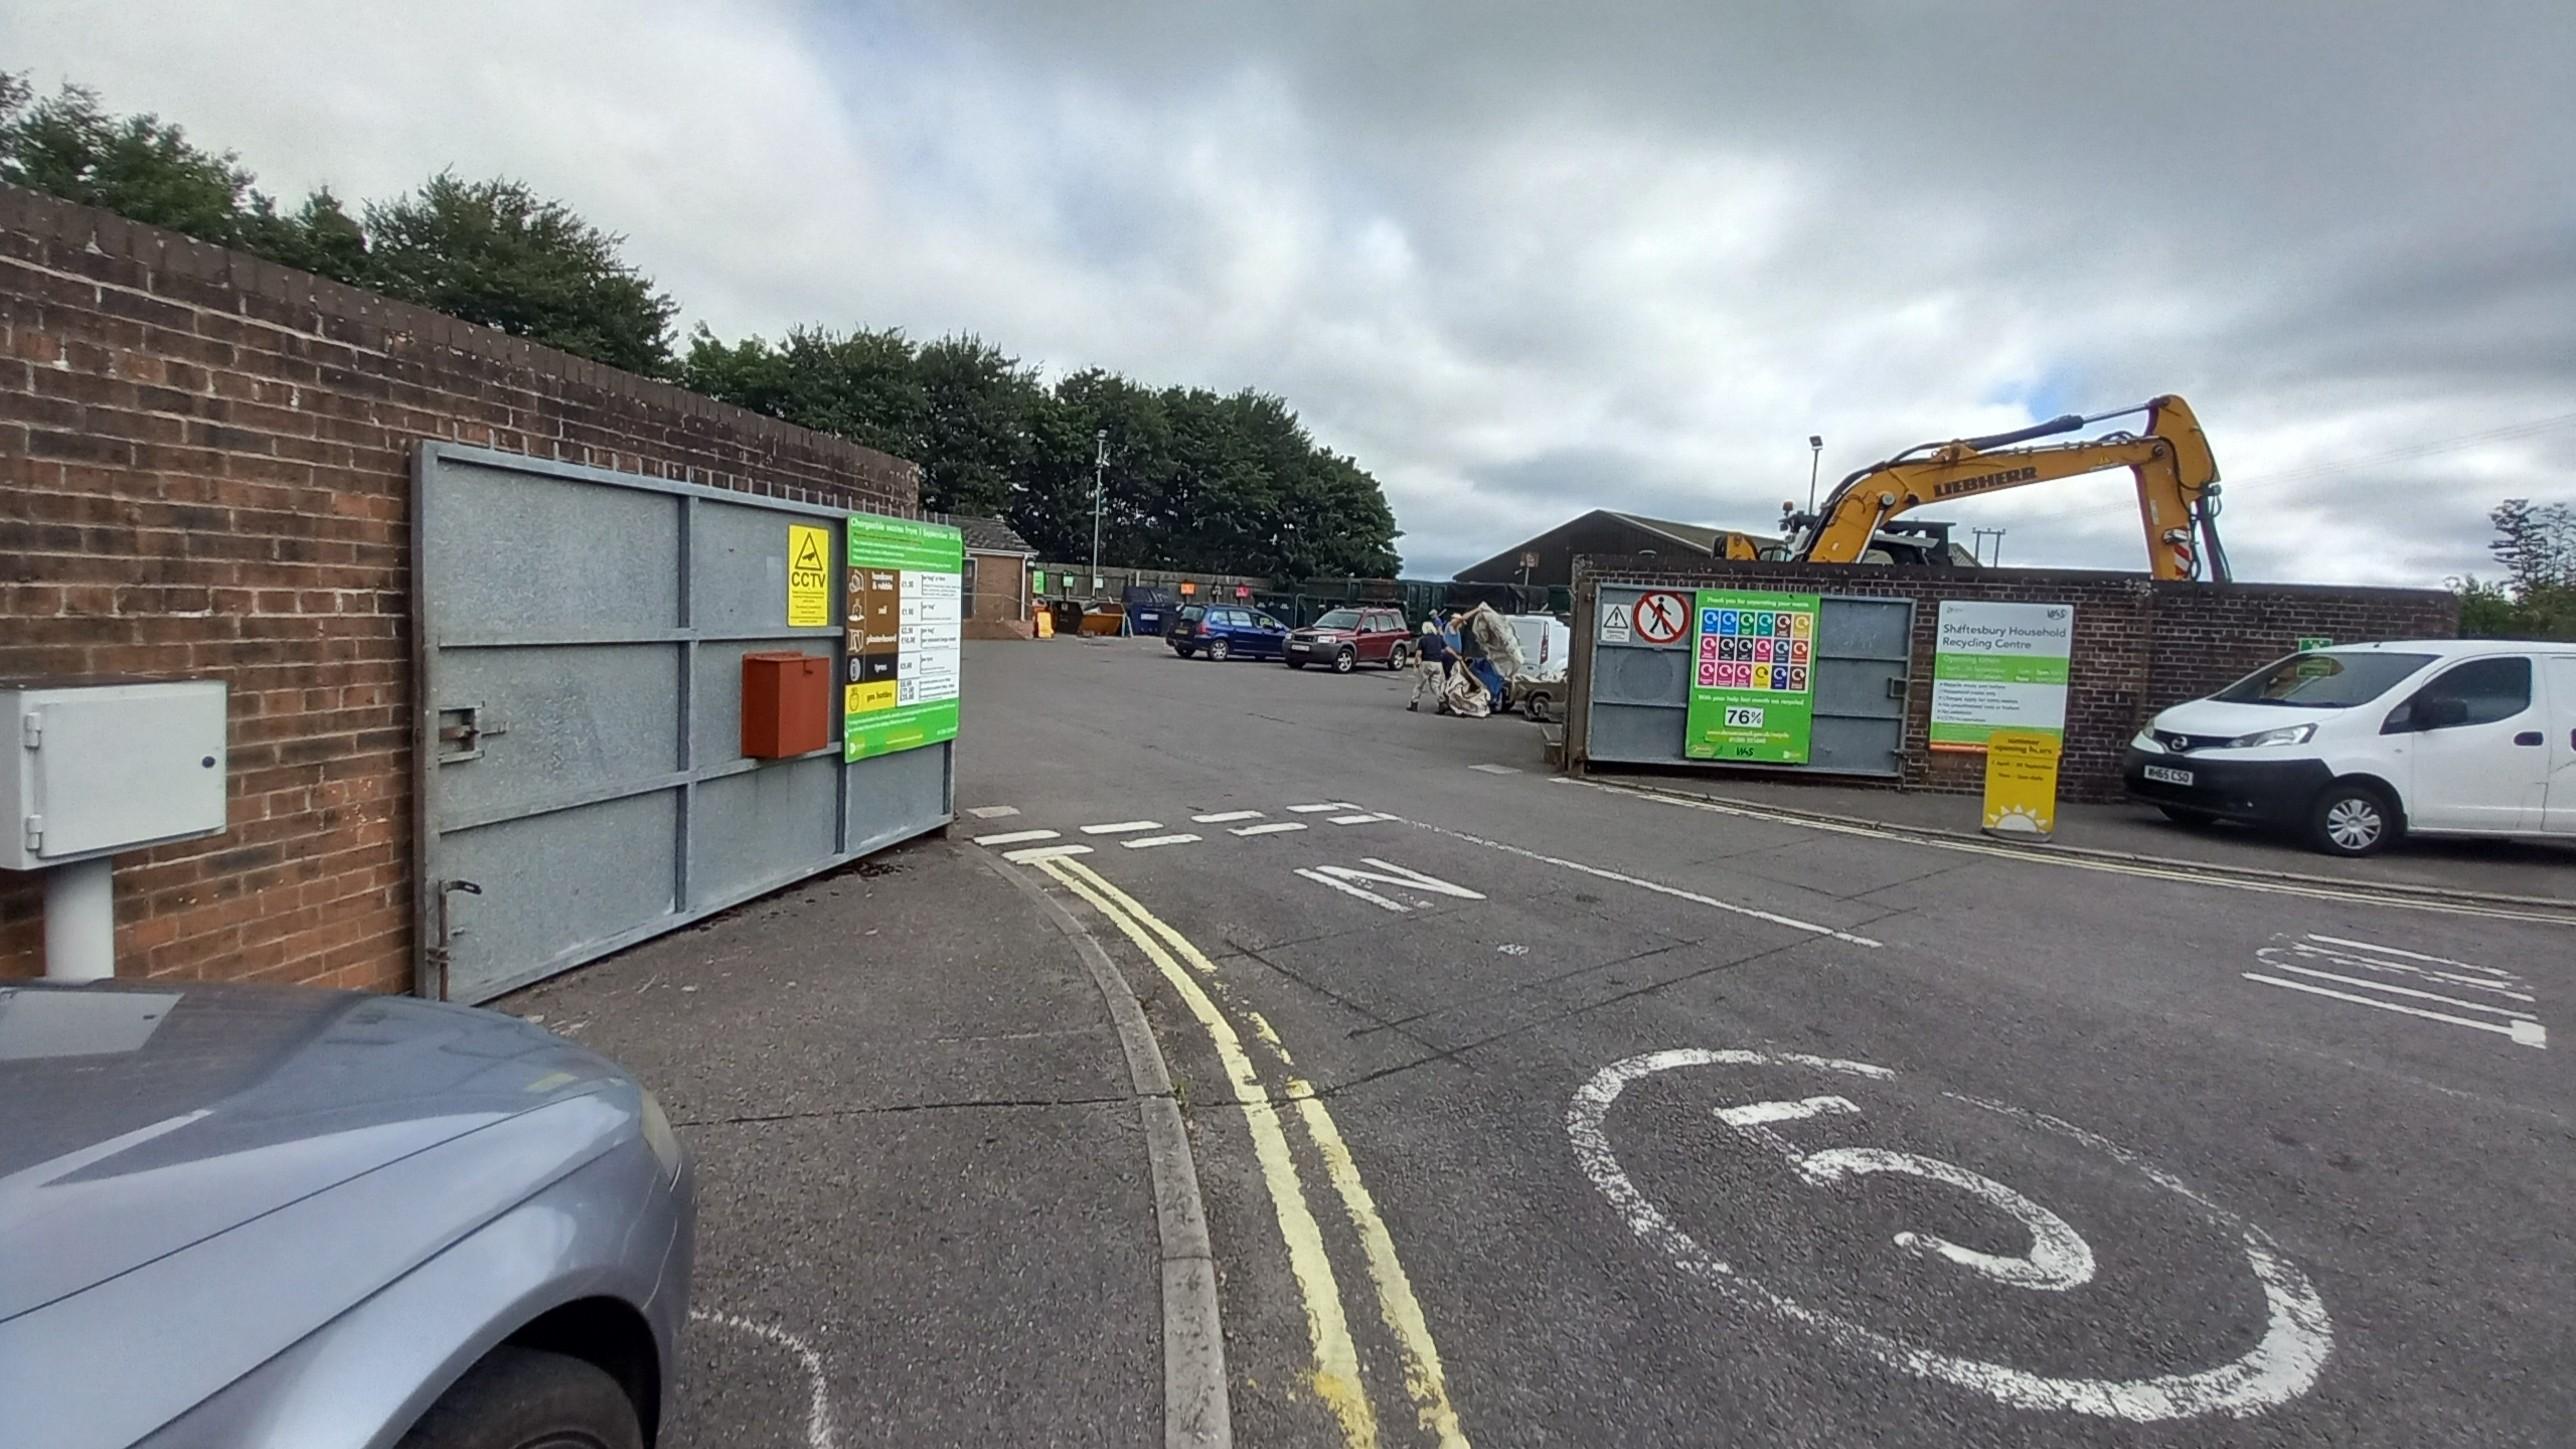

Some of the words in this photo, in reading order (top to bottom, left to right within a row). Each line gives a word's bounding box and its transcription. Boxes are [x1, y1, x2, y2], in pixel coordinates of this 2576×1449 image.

[1934, 466, 2038, 497] LIEBHERR
[791, 571, 826, 588] CCTV
[1943, 624, 2007, 638] Shaftesbury
[2009, 626, 2067, 638] Household
[1942, 637, 1992, 650] Recycling
[1995, 639, 2032, 649] Centre
[1727, 709, 1762, 725] 76%
[1713, 1095, 2097, 1292] 5
